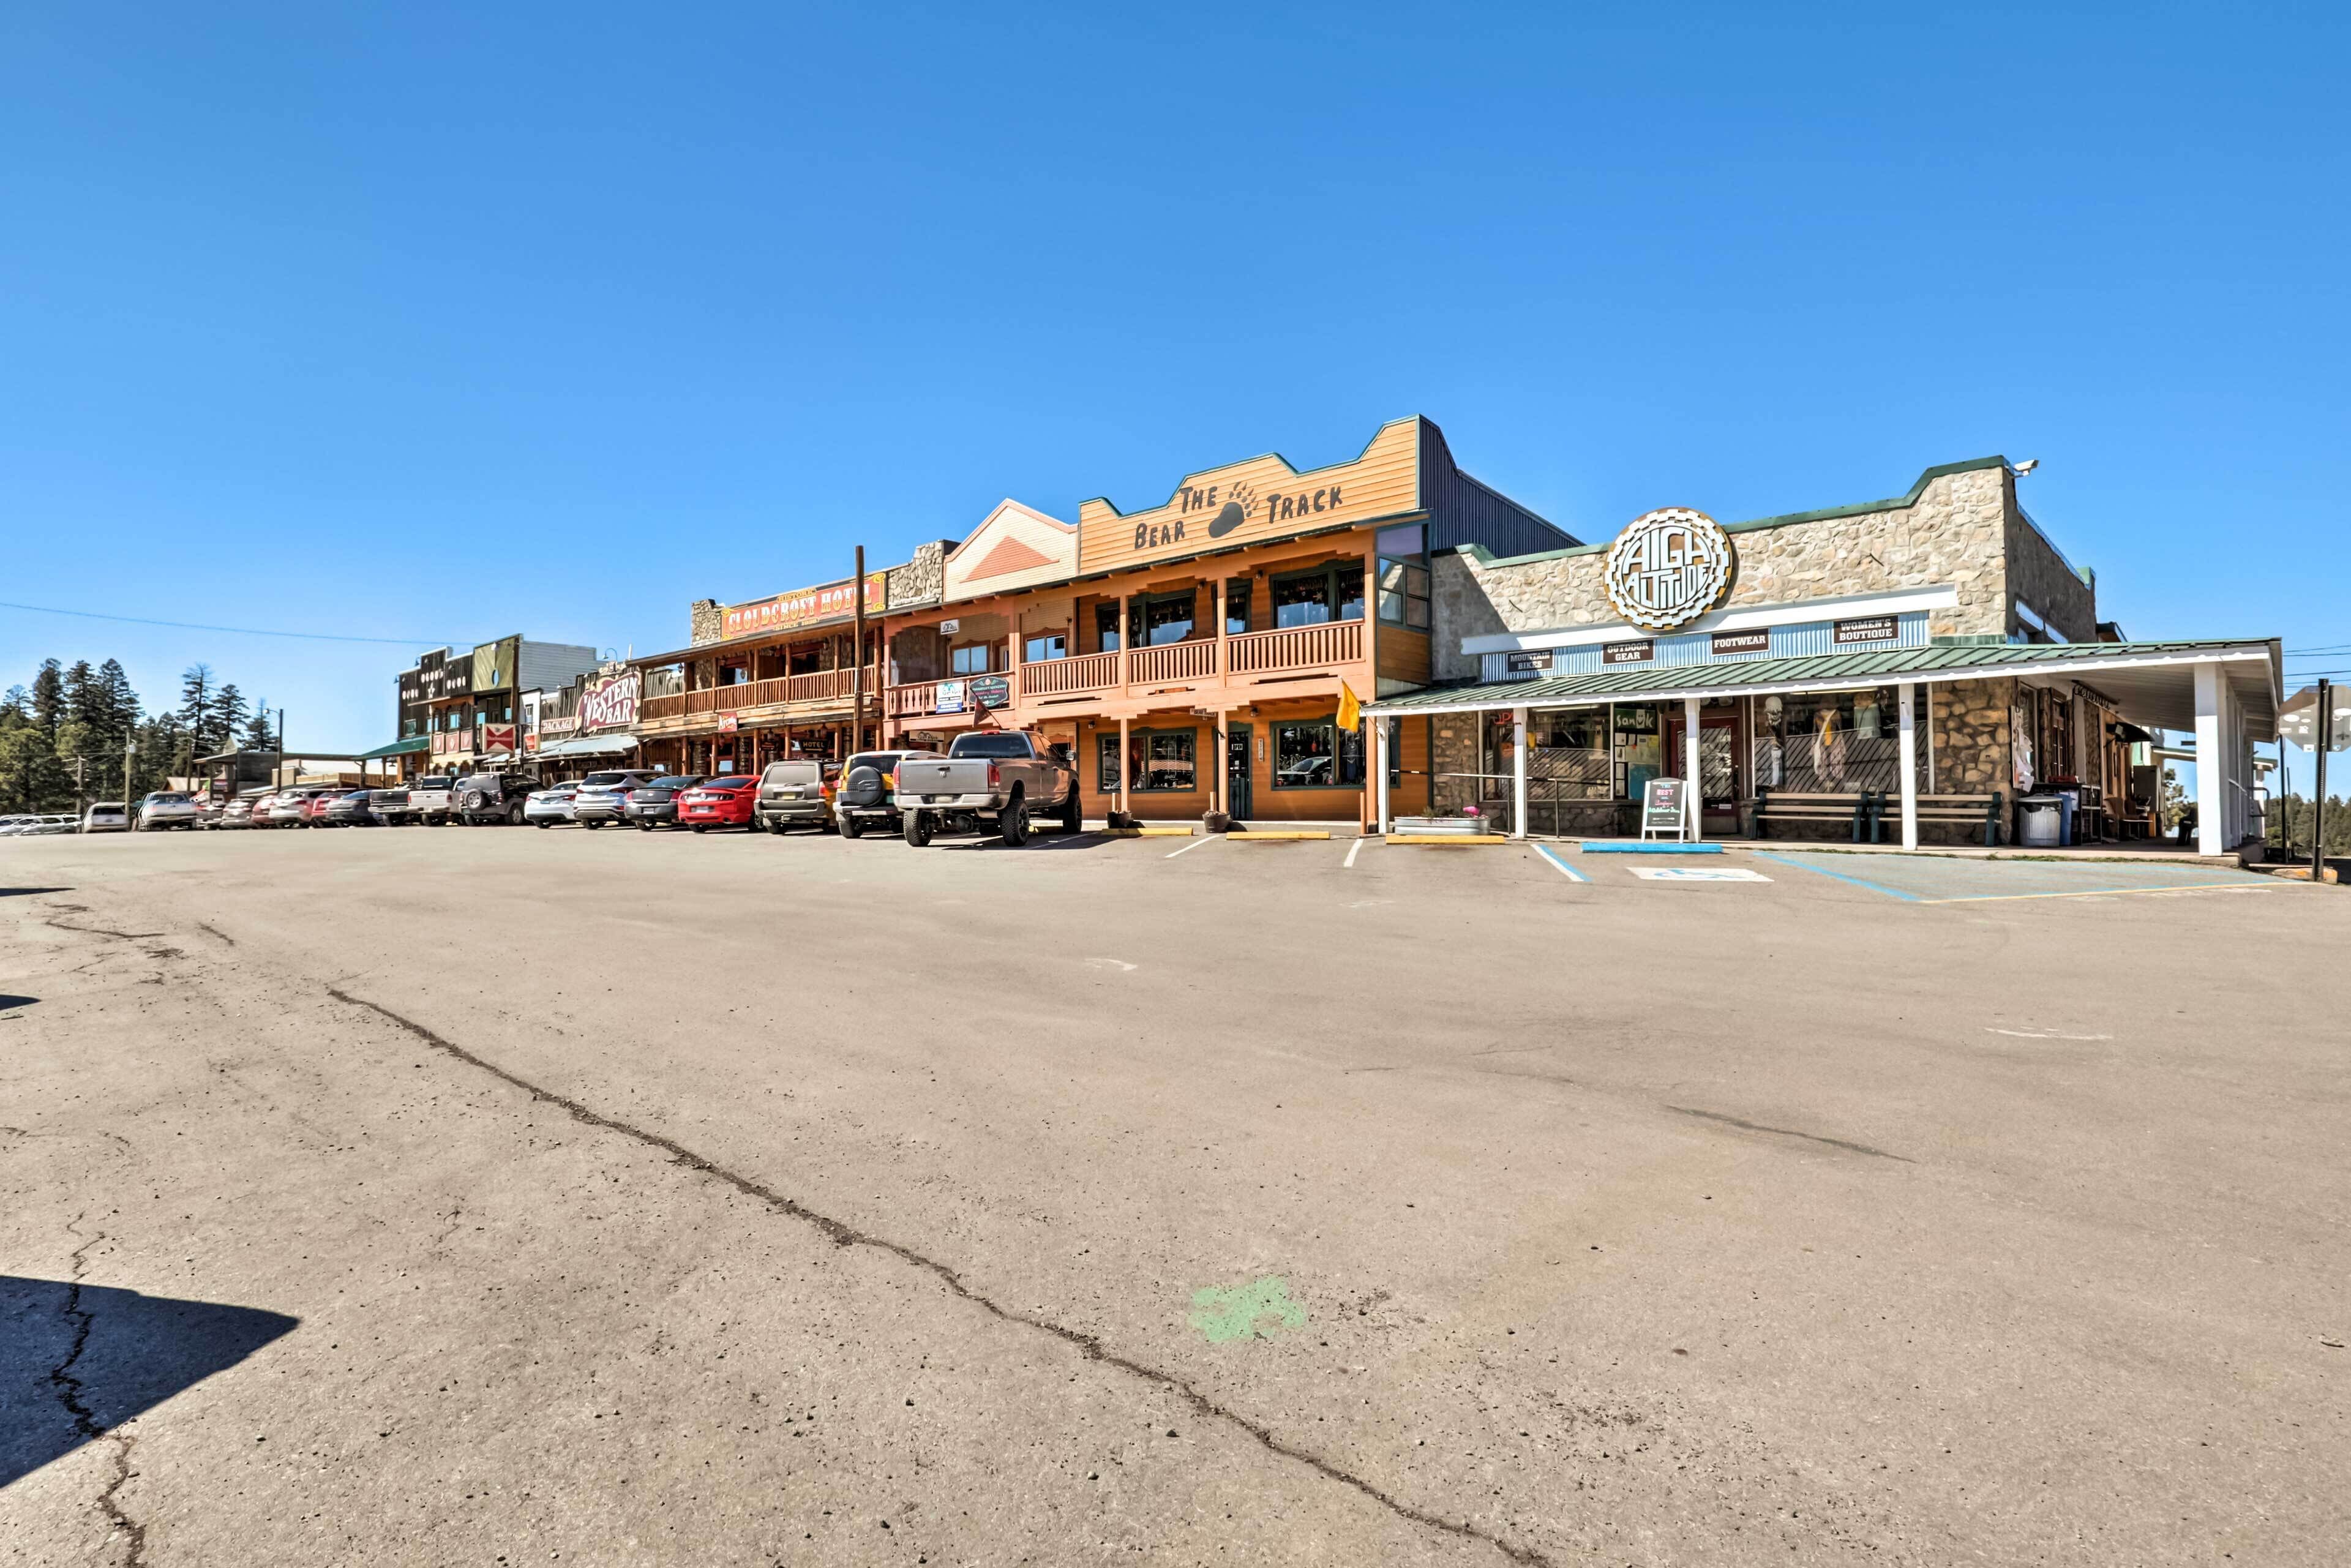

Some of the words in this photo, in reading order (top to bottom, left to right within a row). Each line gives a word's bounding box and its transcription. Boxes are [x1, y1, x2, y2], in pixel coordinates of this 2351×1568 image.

[1179, 486, 1218, 514] THE
[1134, 520, 1185, 549] BEAR
[1266, 486, 1343, 523] TRACK
[1622, 526, 1711, 574] HIGH
[1623, 562, 1711, 610] ALTITUDE
[729, 595, 816, 632] CLOUDCROFT
[820, 583, 872, 613] HOTL
[1840, 618, 1891, 631] WOMEN'S
[1839, 628, 1892, 641] BOUTIQUE
[1607, 642, 1649, 653] OUTDOOR
[1714, 636, 1766, 648] FOOTWEAR
[1510, 651, 1550, 662] MOUNTAIN
[1615, 651, 1641, 661] GEAR
[1518, 660, 1542, 670] BIKES
[583, 677, 637, 727] WESTERN
[605, 699, 632, 724] BAR
[543, 719, 573, 732] PACKAGE
